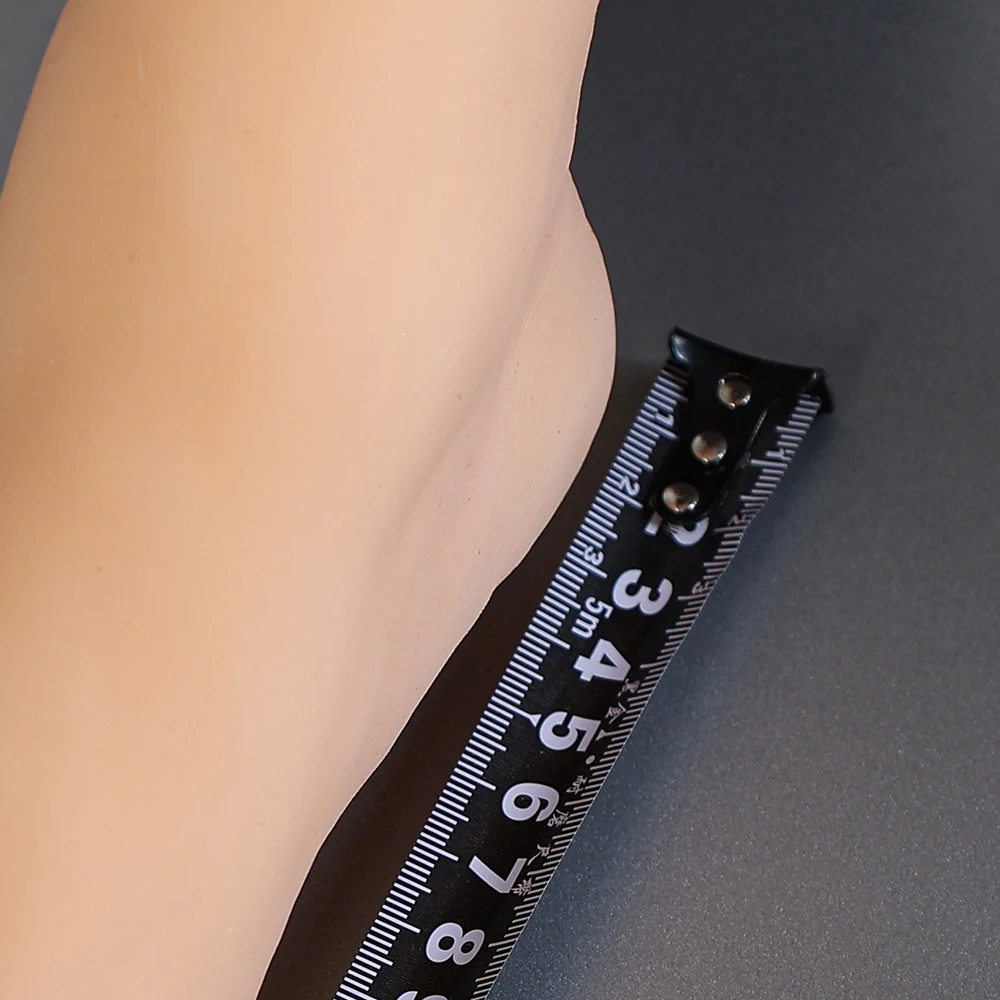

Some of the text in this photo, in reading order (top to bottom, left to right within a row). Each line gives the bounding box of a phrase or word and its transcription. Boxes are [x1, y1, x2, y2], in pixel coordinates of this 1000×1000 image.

[618, 476, 641, 497] 2
[583, 545, 605, 567] 3
[612, 569, 673, 615] 3
[572, 596, 614, 639] 5m
[574, 638, 631, 682] 4
[540, 711, 601, 751] 5
[502, 782, 560, 822] 6
[468, 856, 527, 893] 7
[426, 922, 485, 965] 8
